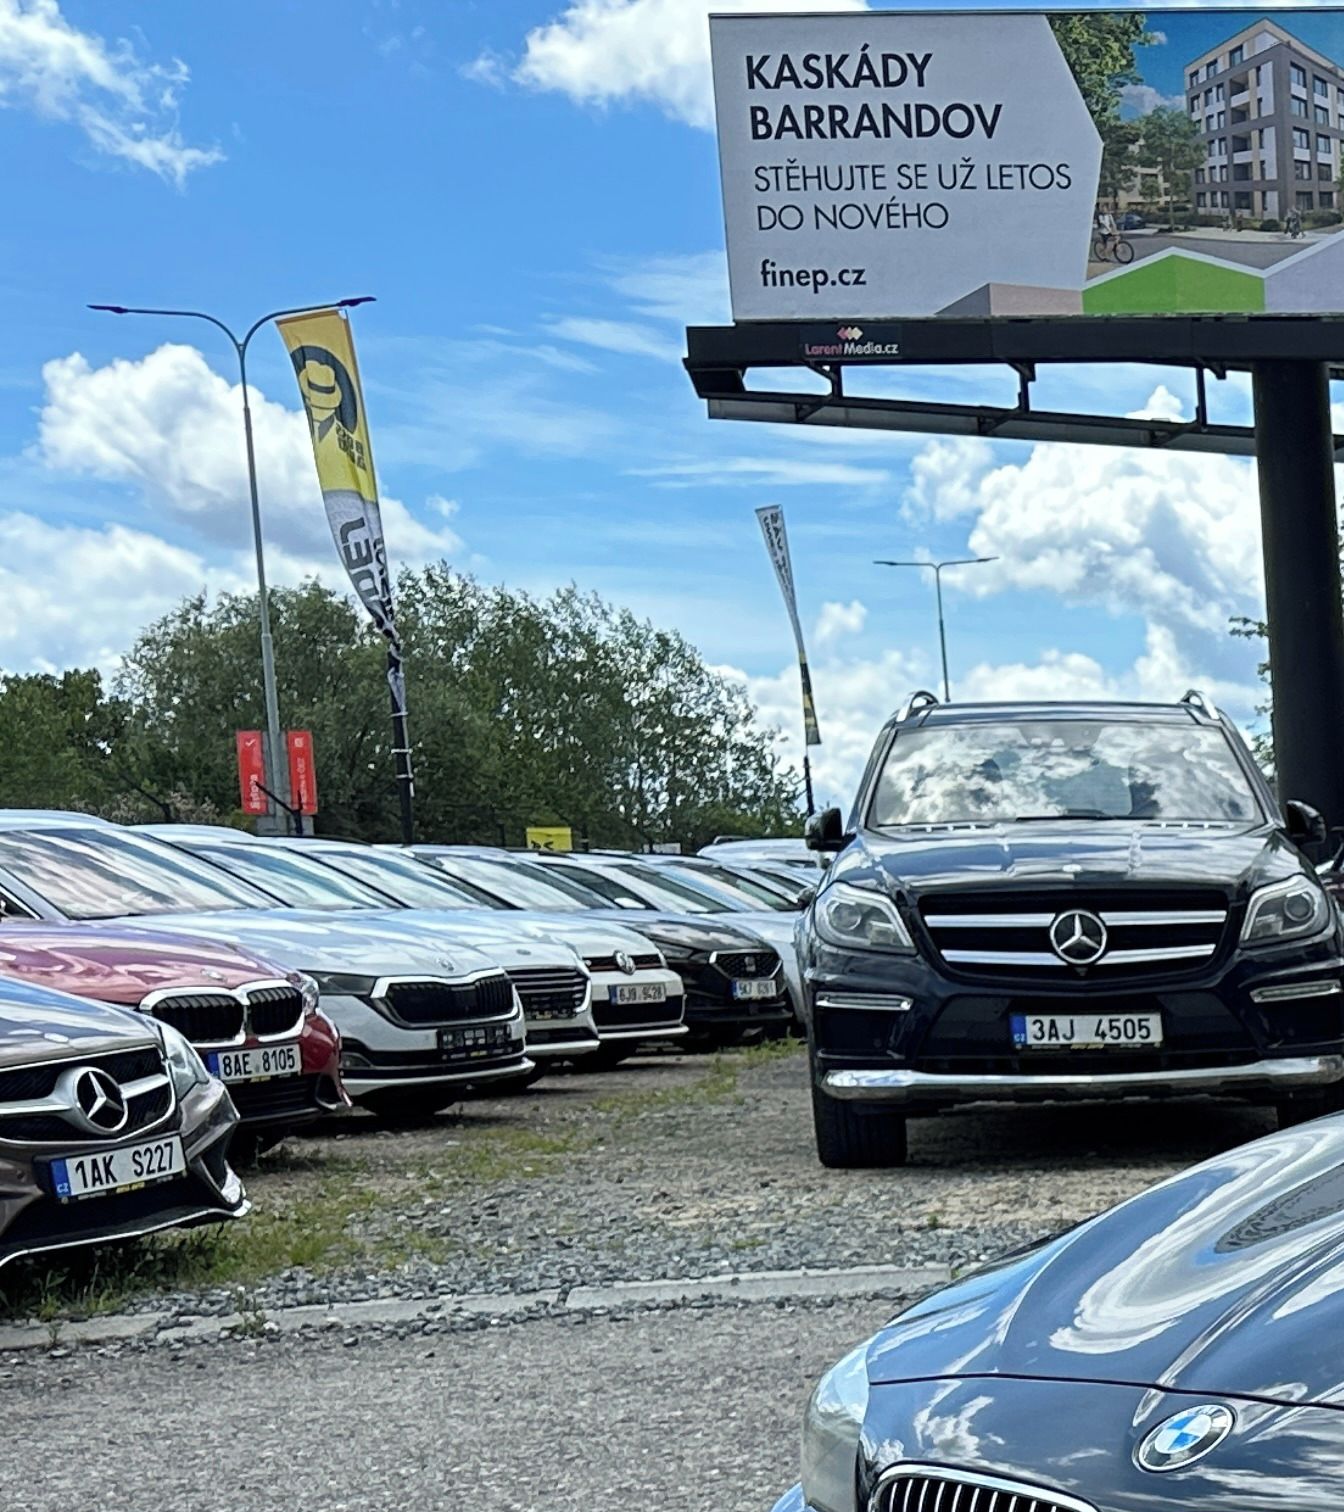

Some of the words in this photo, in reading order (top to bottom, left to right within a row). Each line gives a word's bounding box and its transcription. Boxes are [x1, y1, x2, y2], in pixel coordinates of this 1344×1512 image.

[745, 43, 933, 90] KASKÁDY
[750, 102, 1003, 140] BARRANDOV
[754, 158, 887, 192] STĚHUJTE
[896, 163, 928, 190] SE
[937, 156, 978, 190] UŽ
[985, 163, 1073, 191] LETOS
[756, 203, 804, 231] DO
[813, 195, 950, 231] NOVÉHO
[760, 258, 868, 294] finep.cz
[1031, 1018, 1075, 1042] 3AJ
[1094, 1017, 1151, 1041] 4505
[222, 1052, 252, 1077] 8AE
[262, 1047, 296, 1073] 8105
[75, 1154, 118, 1189] 1AK
[132, 1141, 174, 1178] S227
